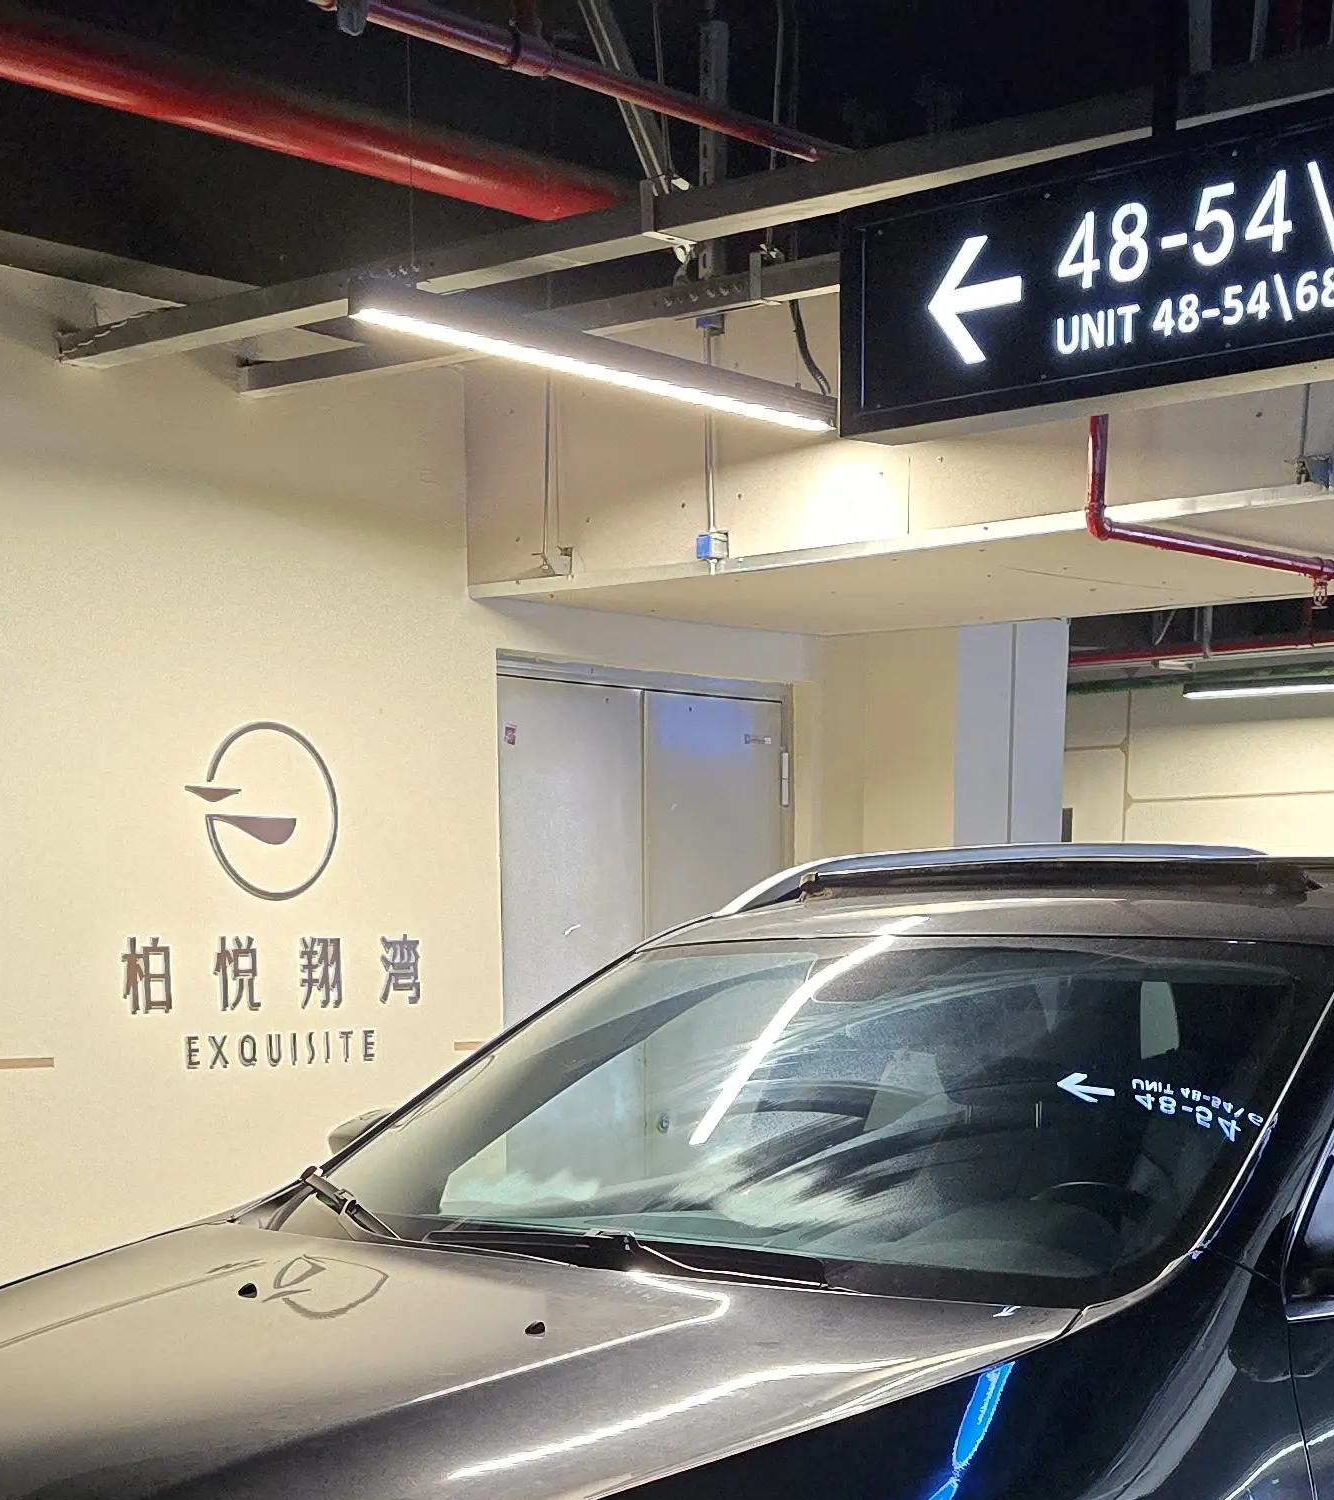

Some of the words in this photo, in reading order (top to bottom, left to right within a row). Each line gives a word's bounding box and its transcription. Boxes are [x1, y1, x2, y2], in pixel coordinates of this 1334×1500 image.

[1055, 304, 1140, 354] UNIT
[120, 934, 422, 1015] 柏悦翔湾
[185, 1029, 376, 1070] EXQUISITE
